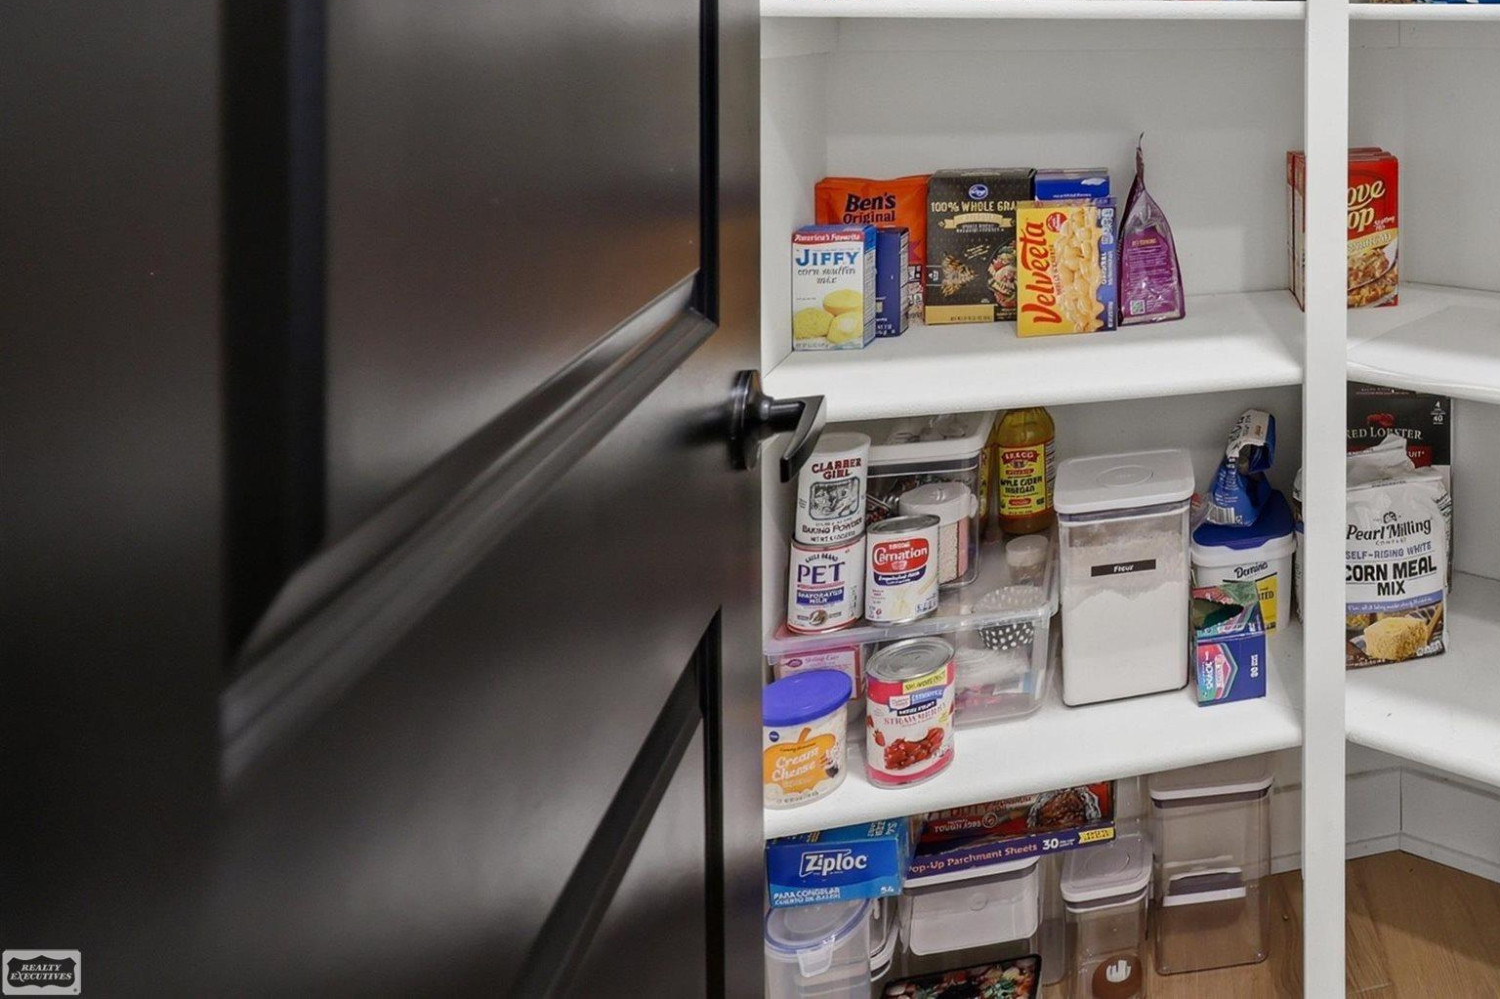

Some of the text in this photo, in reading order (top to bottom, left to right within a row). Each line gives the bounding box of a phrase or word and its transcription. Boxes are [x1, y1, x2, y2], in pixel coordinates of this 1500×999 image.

[845, 192, 896, 212] Ben's
[931, 201, 959, 213] 100%
[961, 201, 995, 212] WHOLE
[843, 211, 895, 224] Original
[795, 249, 859, 266] JIFFY
[1020, 220, 1062, 323] Velveeta
[812, 458, 861, 474] CLABBER
[823, 469, 853, 480] GIRL
[1346, 518, 1432, 541] Pearl Milling
[874, 546, 928, 565] Carnation
[1346, 541, 1432, 560] SELF-RISING WHITE
[797, 562, 845, 584] PET
[1112, 564, 1134, 572] Flour
[1234, 562, 1268, 579] Domino
[1346, 556, 1437, 582] CORN MEAL
[1377, 581, 1406, 596] MIX
[775, 747, 819, 770] Cream
[771, 762, 817, 781] Cheese
[947, 850, 1002, 867] Parchment
[1005, 842, 1037, 856] Sheets
[1042, 838, 1059, 850] 30
[805, 854, 867, 876] Ziploc
